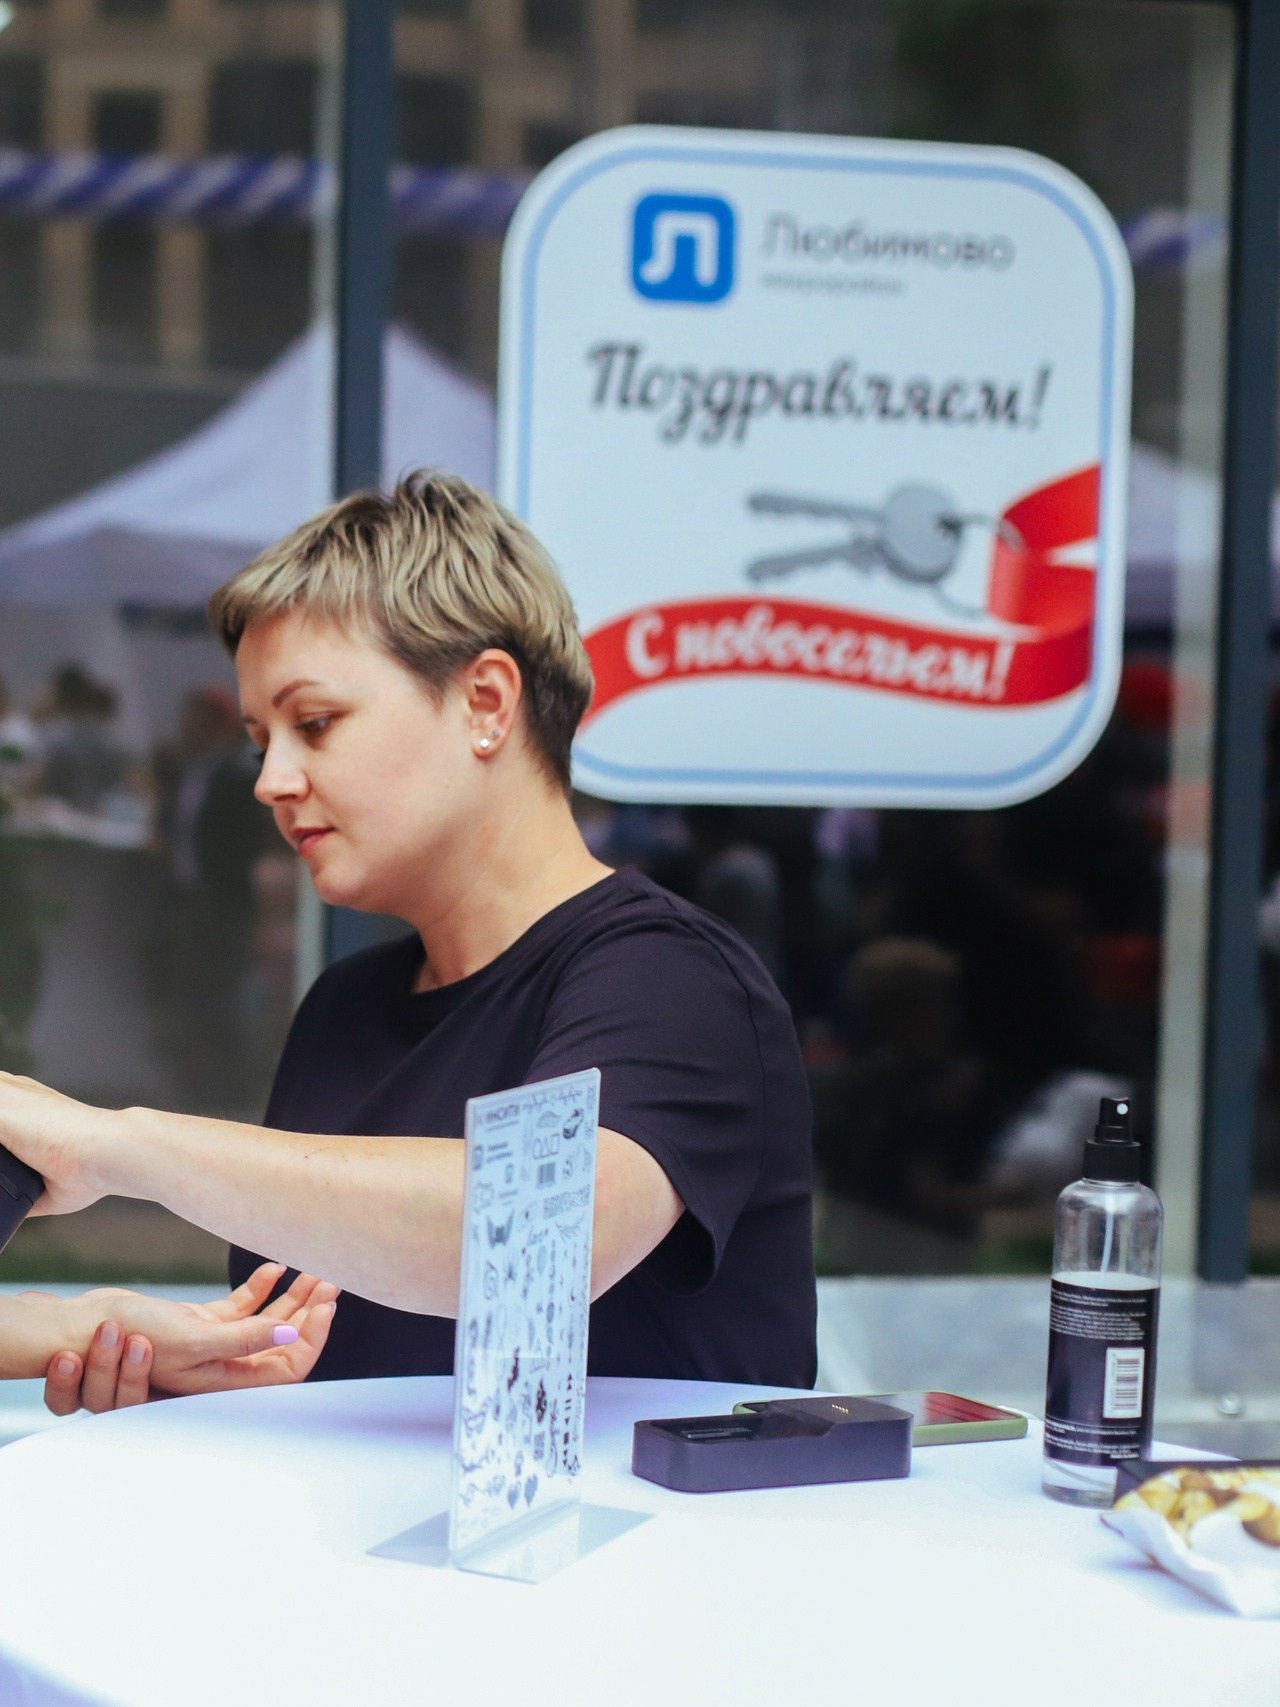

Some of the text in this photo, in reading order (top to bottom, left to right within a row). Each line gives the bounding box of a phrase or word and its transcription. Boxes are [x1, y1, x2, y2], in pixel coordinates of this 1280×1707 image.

[762, 210, 1016, 271] Любимово
[587, 341, 1052, 444] Поздравляем!
[626, 605, 1014, 700] С новосельем!
